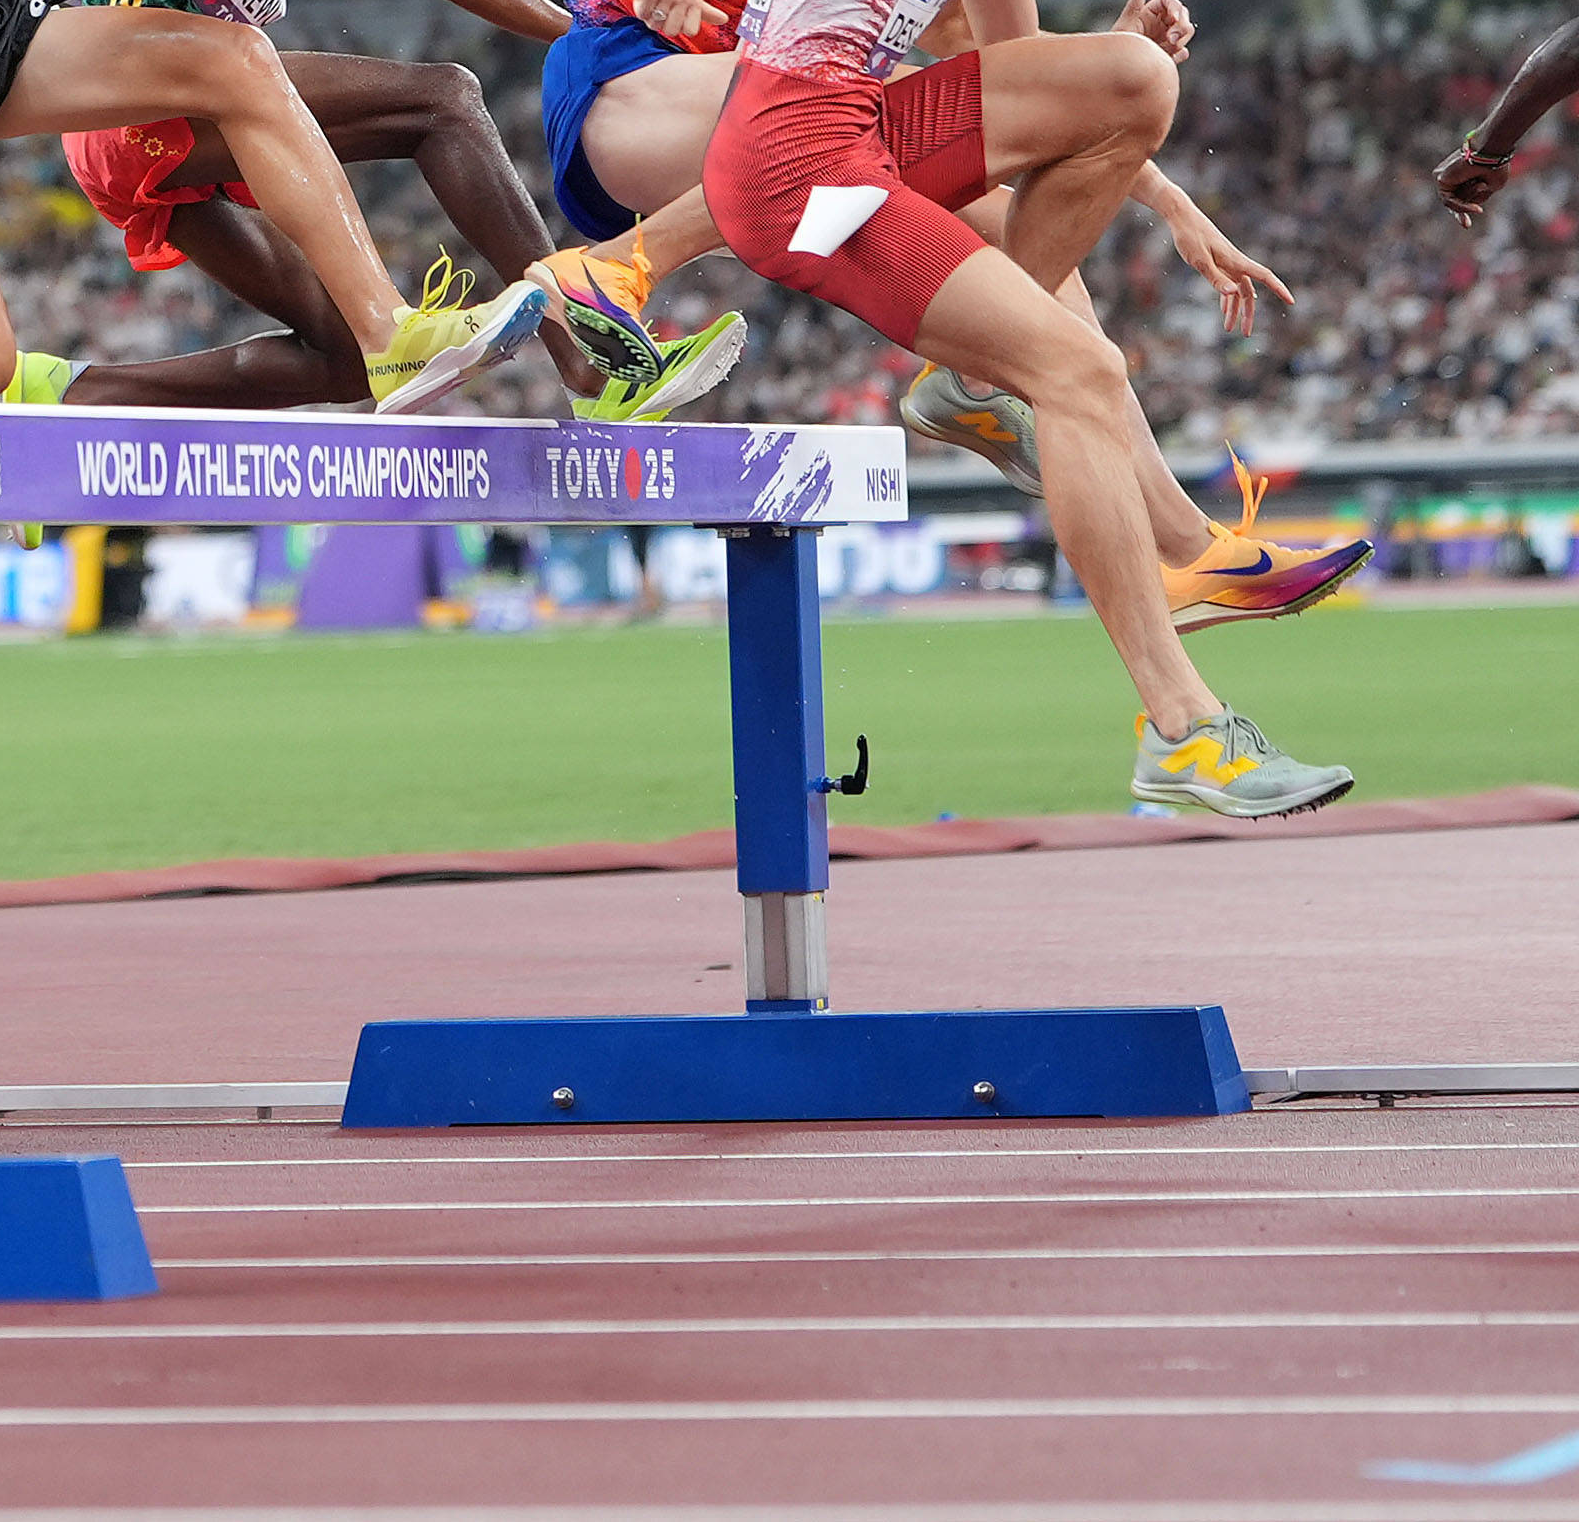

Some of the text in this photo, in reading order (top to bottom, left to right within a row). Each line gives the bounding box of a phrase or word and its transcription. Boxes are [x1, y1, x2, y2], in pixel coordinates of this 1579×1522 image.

[375, 359, 427, 376] RUNNING
[76, 440, 491, 500] WORLD ATHLETICS CHAMPIONSHIPS
[866, 468, 901, 502] NISHI
